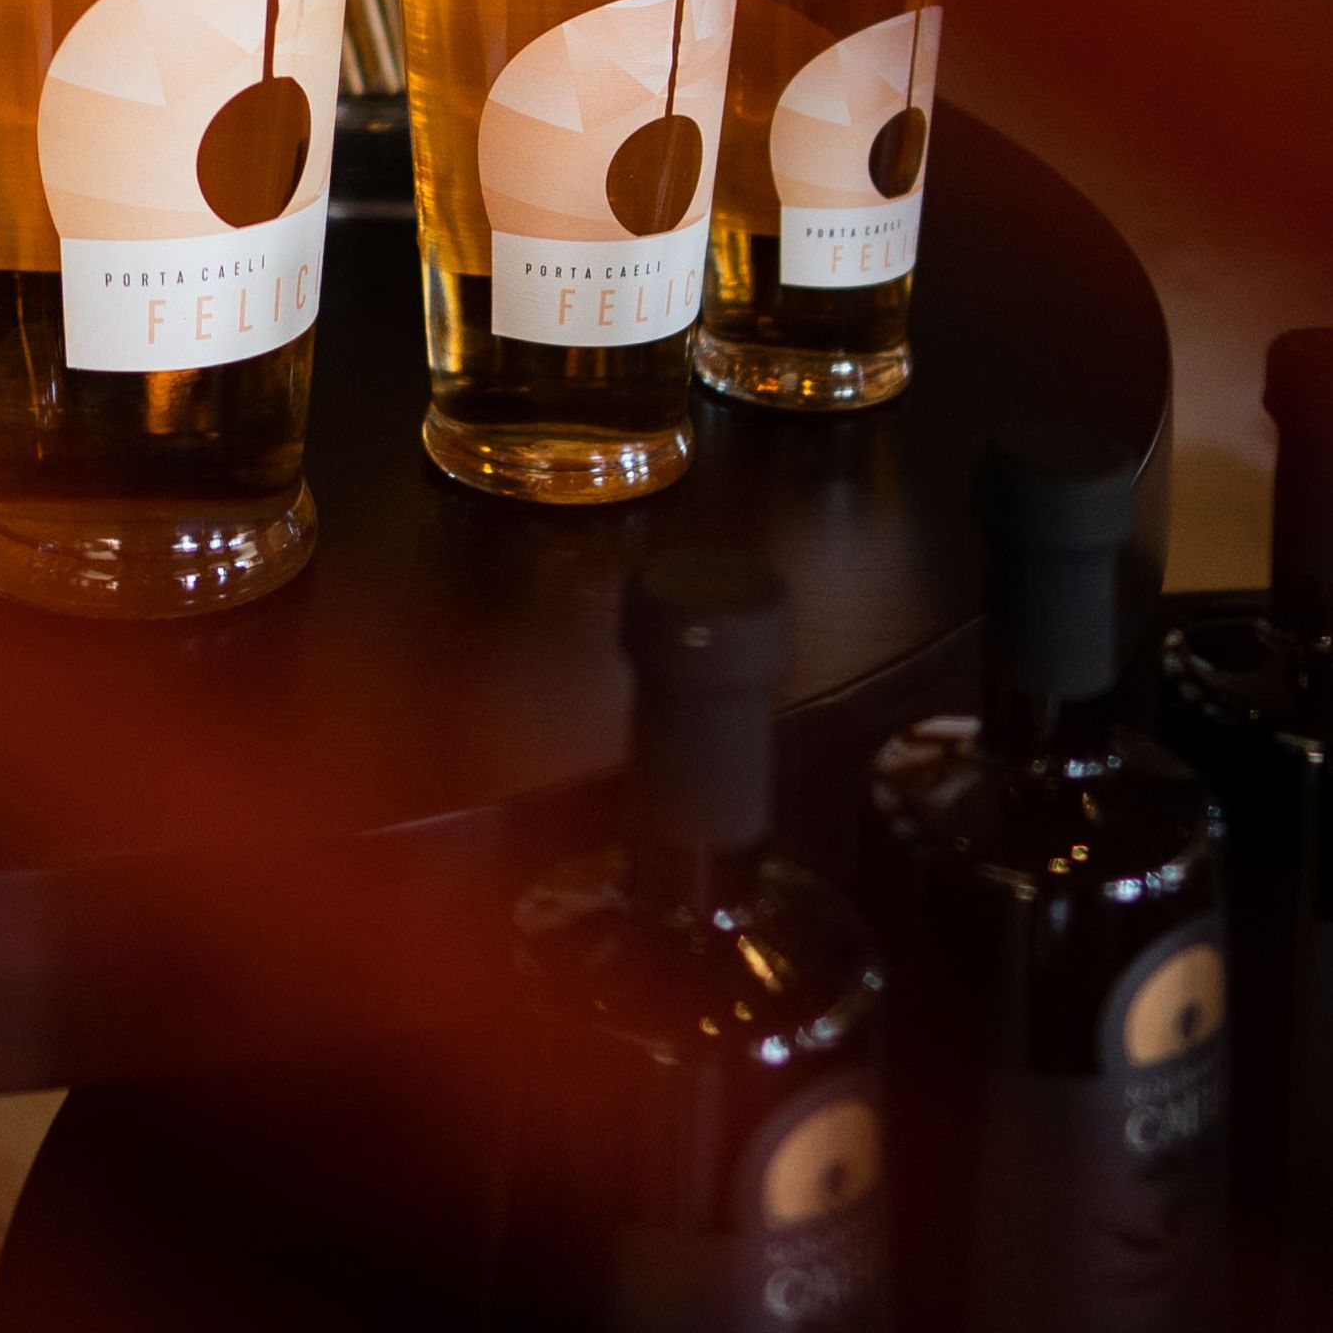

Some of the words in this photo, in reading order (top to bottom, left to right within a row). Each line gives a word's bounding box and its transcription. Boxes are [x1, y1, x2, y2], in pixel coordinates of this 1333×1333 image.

[805, 226, 856, 239] PORTA
[865, 219, 901, 236] CAELI
[104, 271, 185, 287] PORTA
[201, 254, 266, 282] CAELI
[525, 263, 592, 280] PORTA
[605, 260, 661, 279] CAELI
